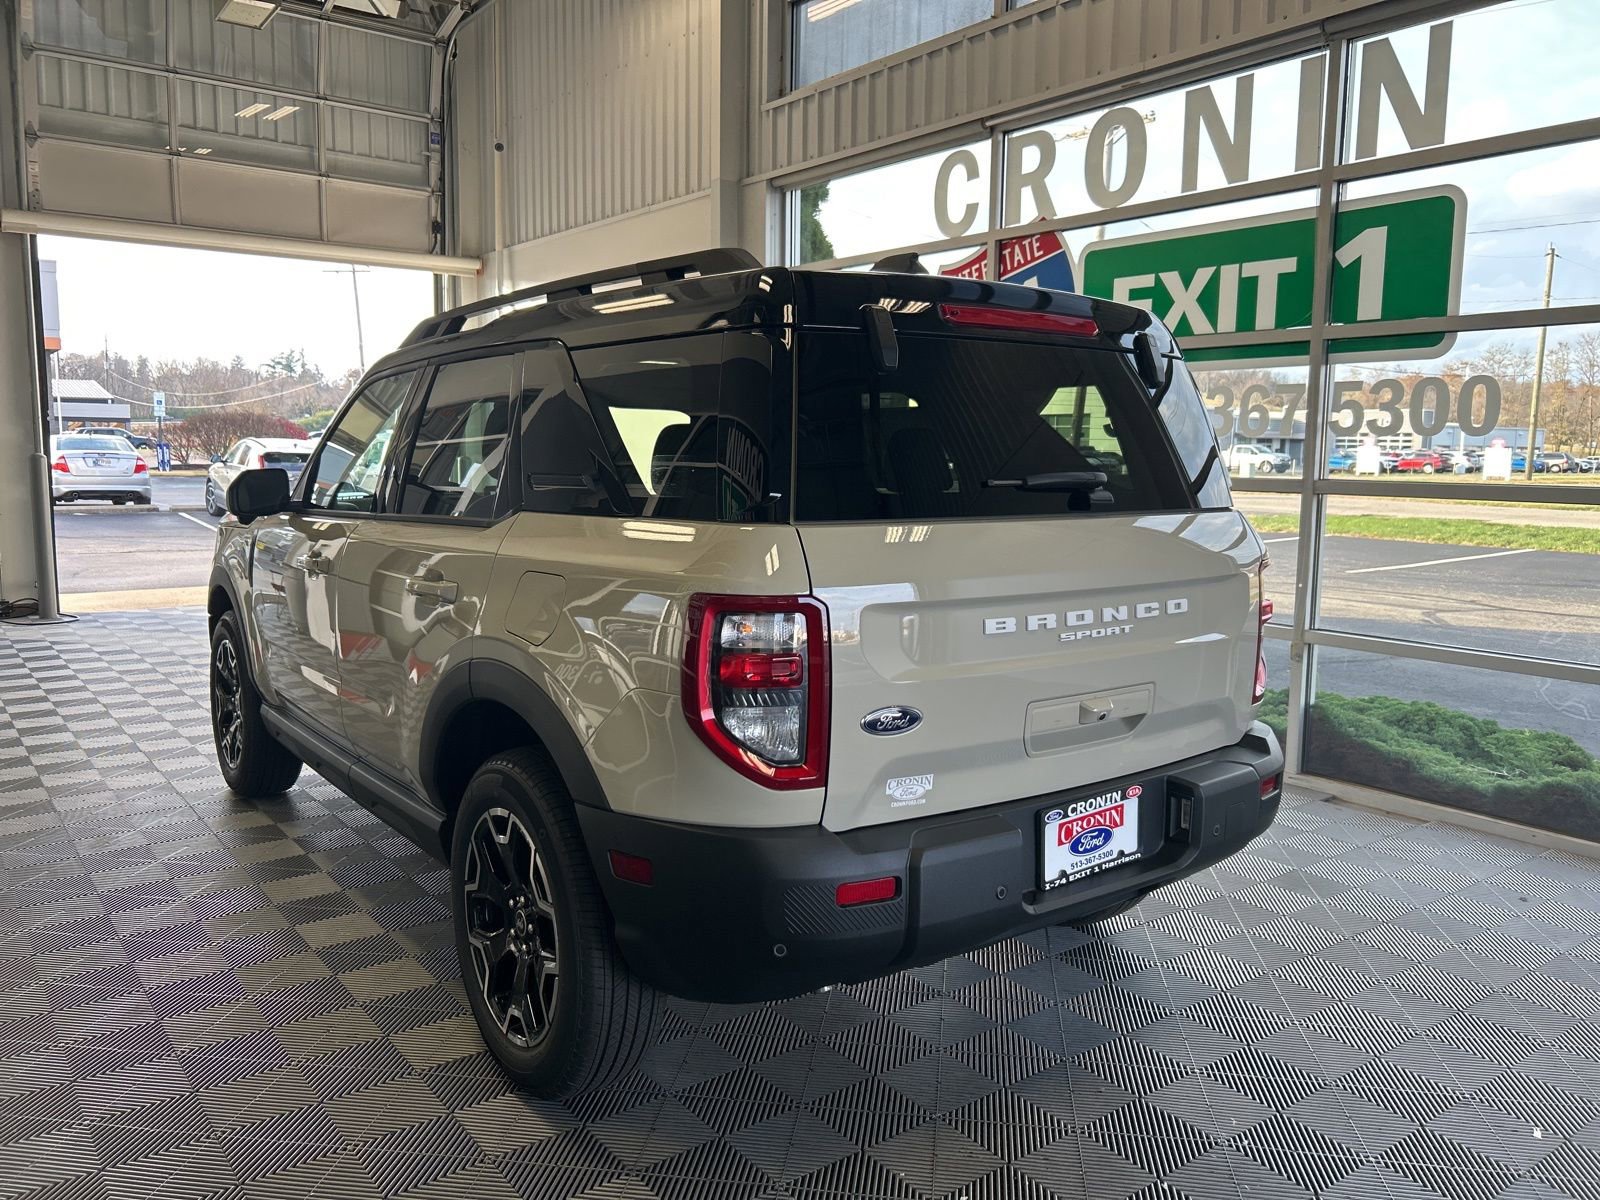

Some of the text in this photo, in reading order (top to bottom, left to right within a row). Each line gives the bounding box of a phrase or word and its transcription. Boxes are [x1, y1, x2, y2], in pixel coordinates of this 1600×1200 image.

[934, 21, 1454, 238] CRONIN
[1113, 226, 1388, 335] EXIT 1
[983, 598, 1188, 635] BRONCO
[1058, 624, 1134, 642] SPORT
[876, 711, 911, 730] Ford
[888, 775, 932, 791] CRONIN
[900, 787, 919, 798] Ford
[1067, 791, 1122, 817] CRONIN
[1061, 807, 1123, 843] CRONIN
[1078, 831, 1105, 852] Ford
[1045, 877, 1067, 890] I-74
[1069, 868, 1092, 881] EXIT
[1102, 853, 1141, 870] Harrison
[1070, 849, 1114, 871] 513-367-5300
